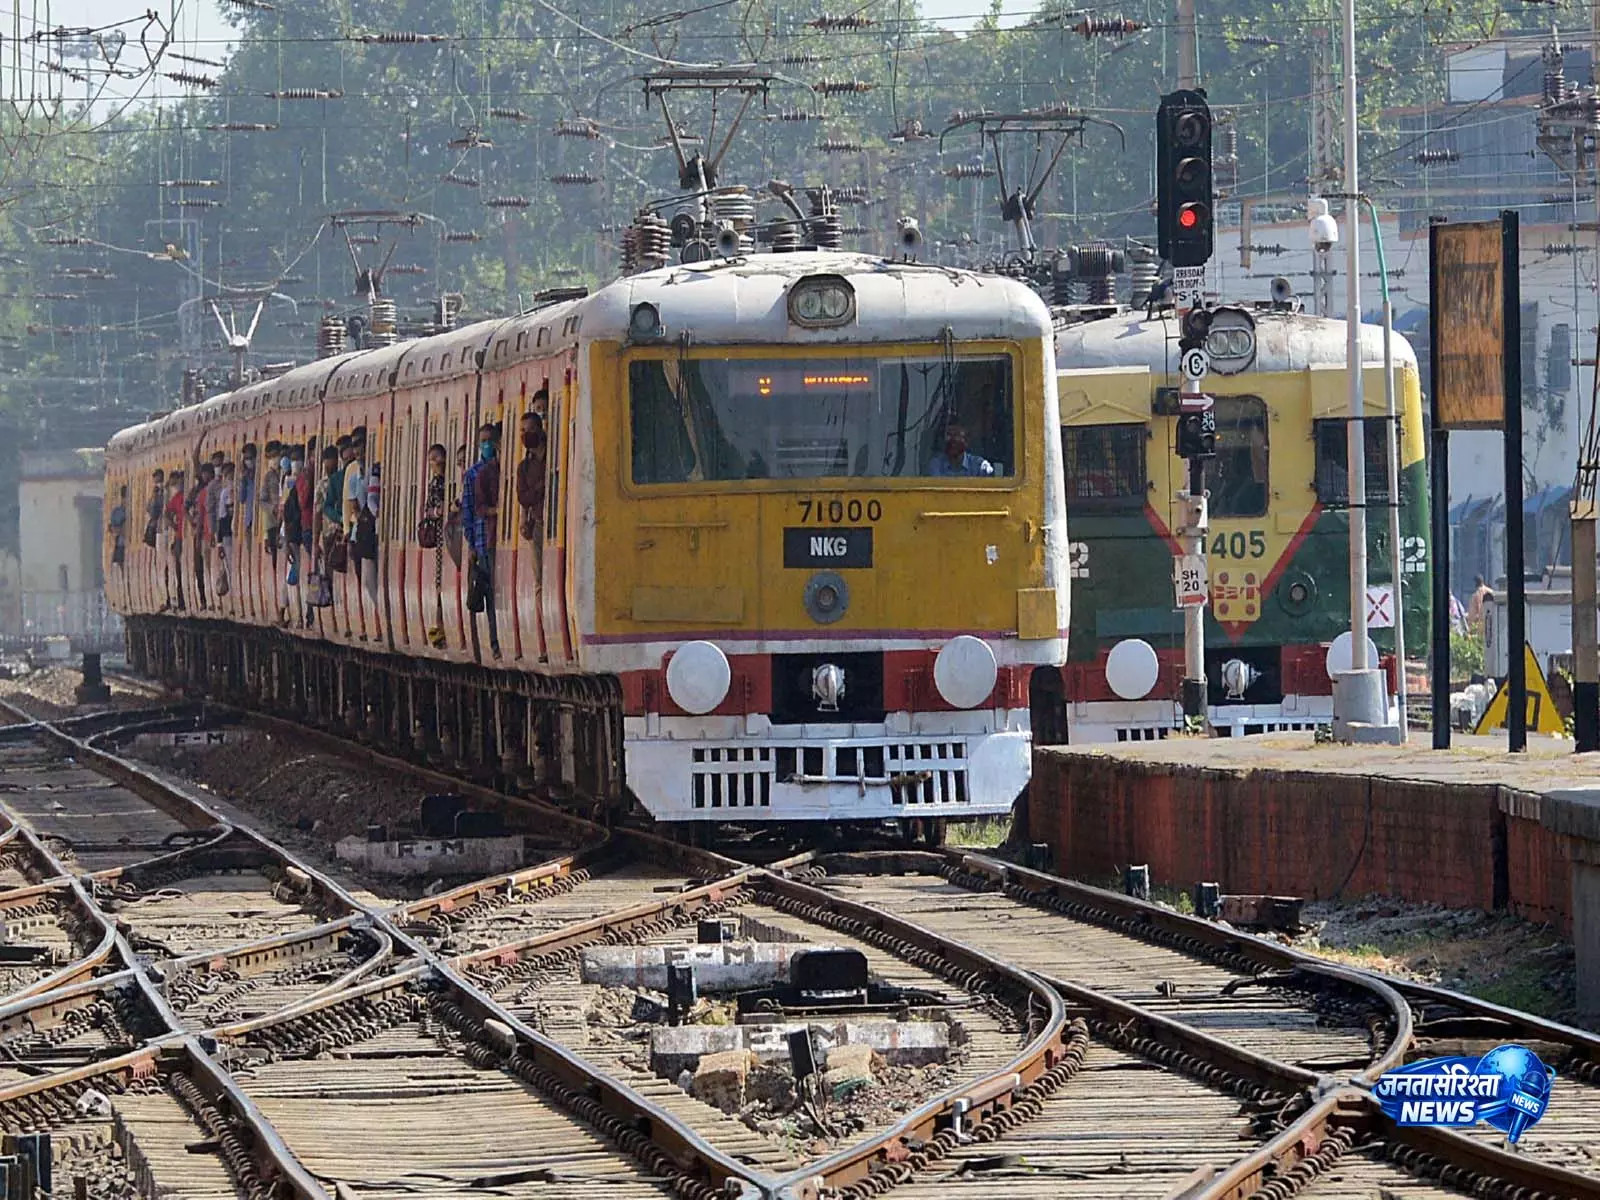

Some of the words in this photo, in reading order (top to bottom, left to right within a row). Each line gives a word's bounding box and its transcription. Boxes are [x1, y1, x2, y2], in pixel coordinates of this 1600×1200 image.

[1203, 410, 1215, 420] SH
[1201, 420, 1216, 431] 20
[797, 499, 882, 523] 71000
[810, 536, 848, 556] NKG
[1182, 569, 1199, 580] SH
[1183, 580, 1200, 591] 20
